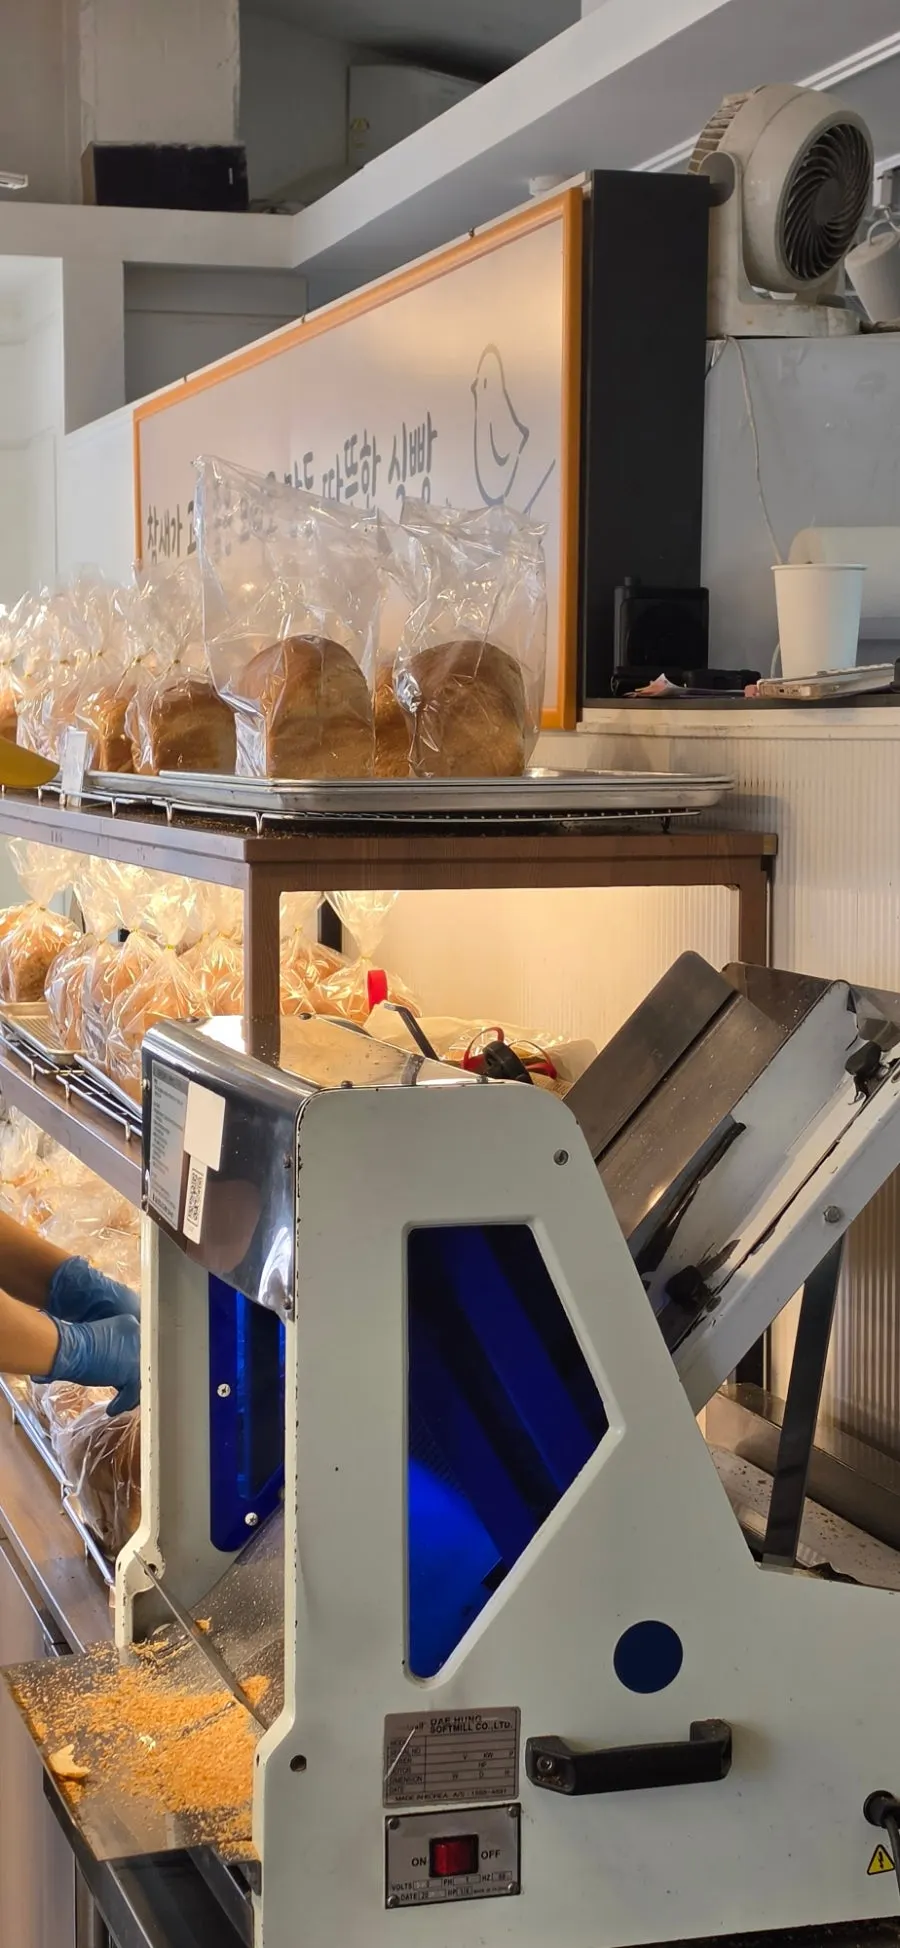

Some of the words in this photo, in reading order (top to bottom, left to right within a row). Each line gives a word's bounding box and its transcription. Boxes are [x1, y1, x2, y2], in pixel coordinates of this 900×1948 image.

[147, 504, 183, 565] 참새가
[388, 410, 438, 505] 식빵
[430, 1722, 472, 1734] SOFTMILL
[411, 1857, 427, 1867] ON
[481, 1849, 500, 1860] OFF
[391, 1882, 412, 1891] VOLTS
[400, 1892, 418, 1901] DATE
